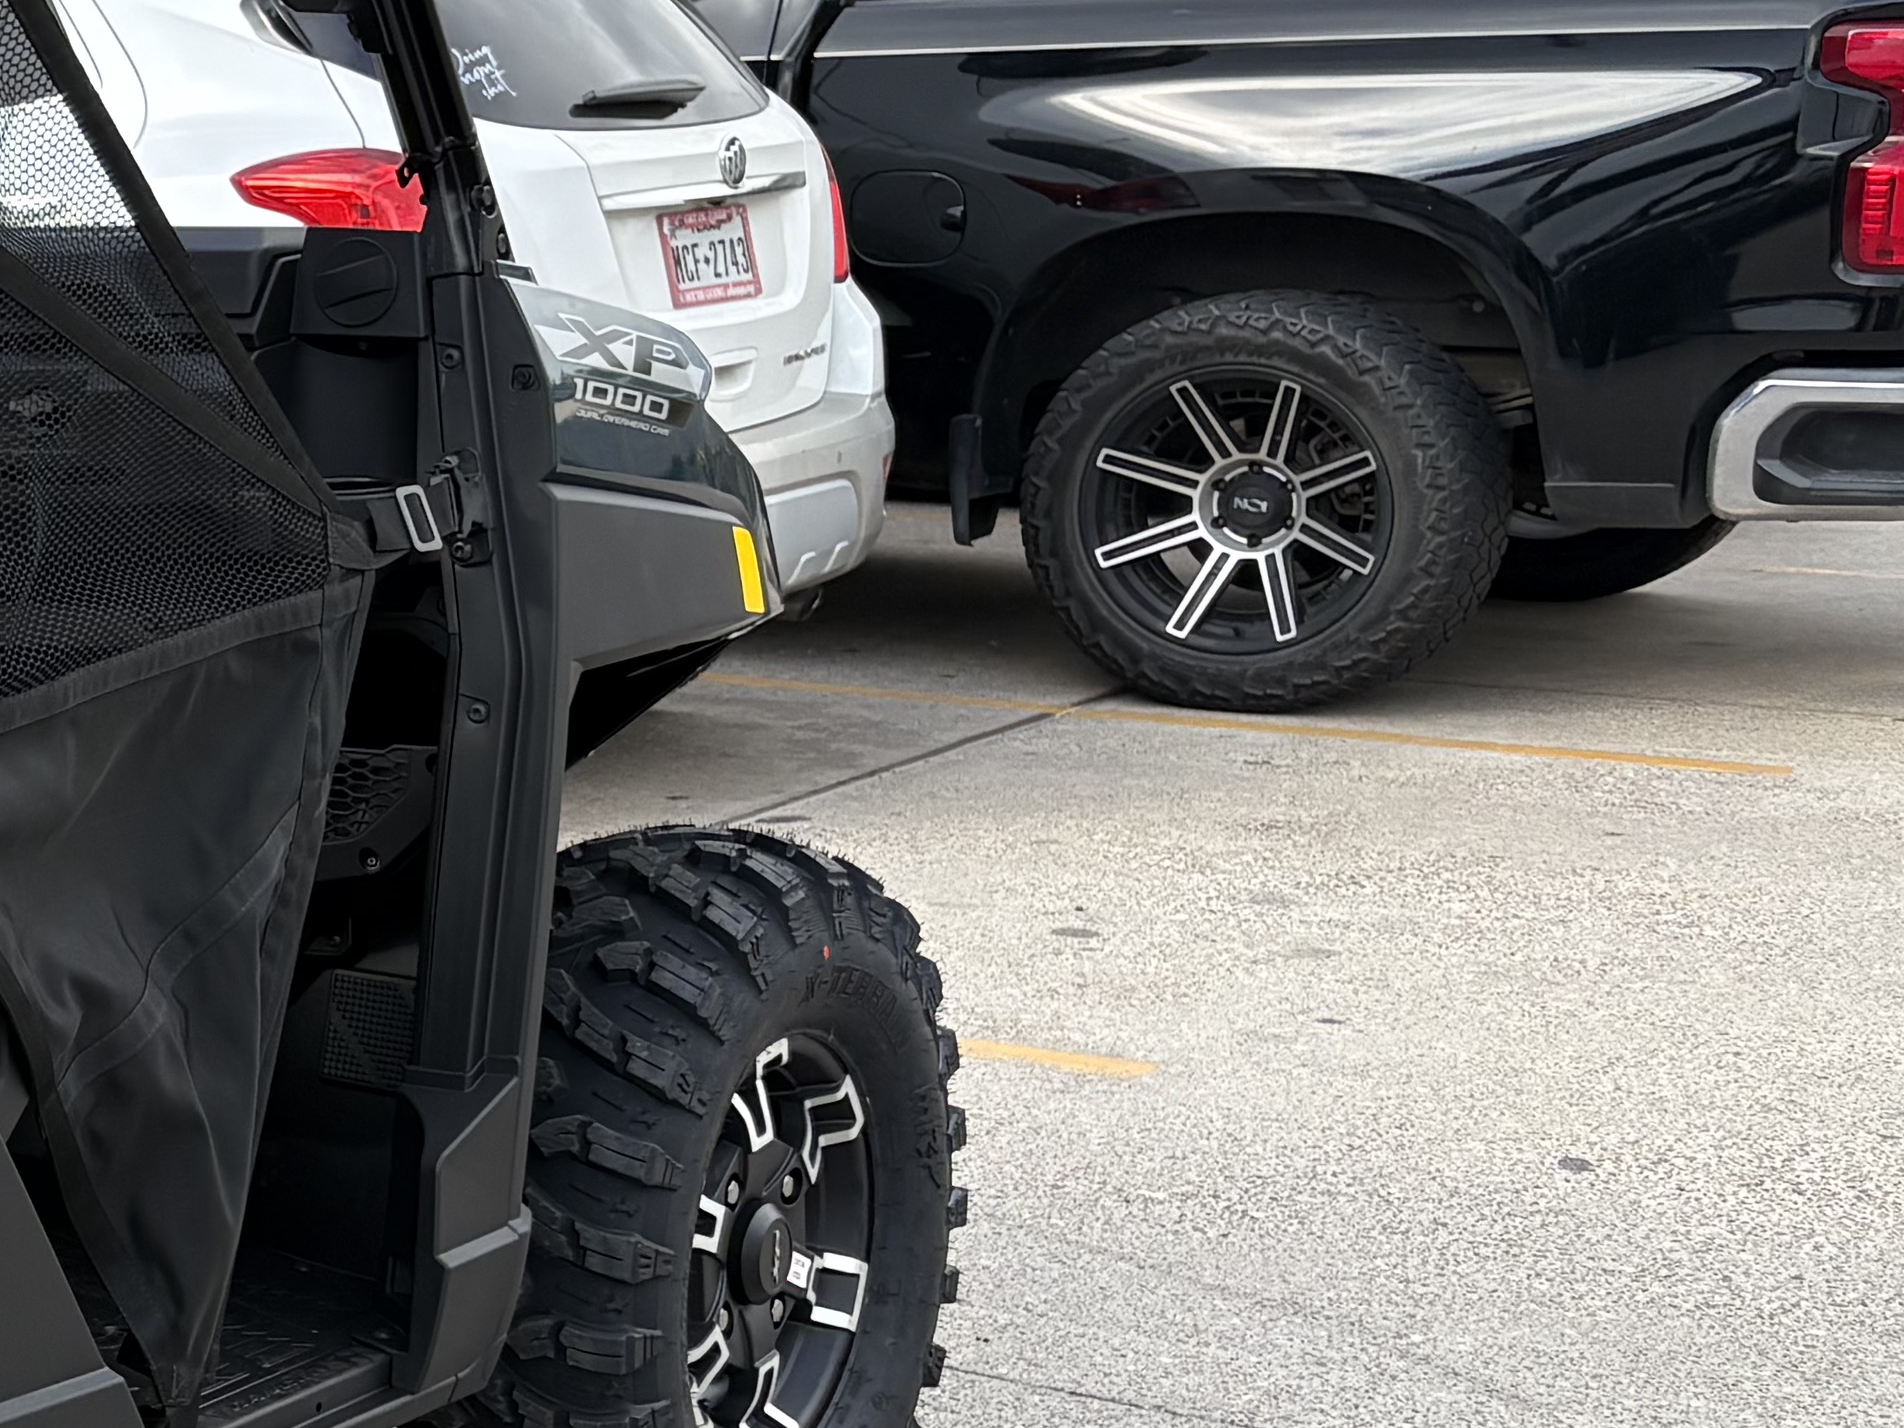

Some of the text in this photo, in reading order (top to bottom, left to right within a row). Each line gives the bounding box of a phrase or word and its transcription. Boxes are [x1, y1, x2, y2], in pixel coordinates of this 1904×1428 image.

[556, 312, 692, 378] XP
[573, 377, 670, 421] 1000
[576, 406, 602, 421] DUAL
[602, 412, 649, 432] OVERHEAD
